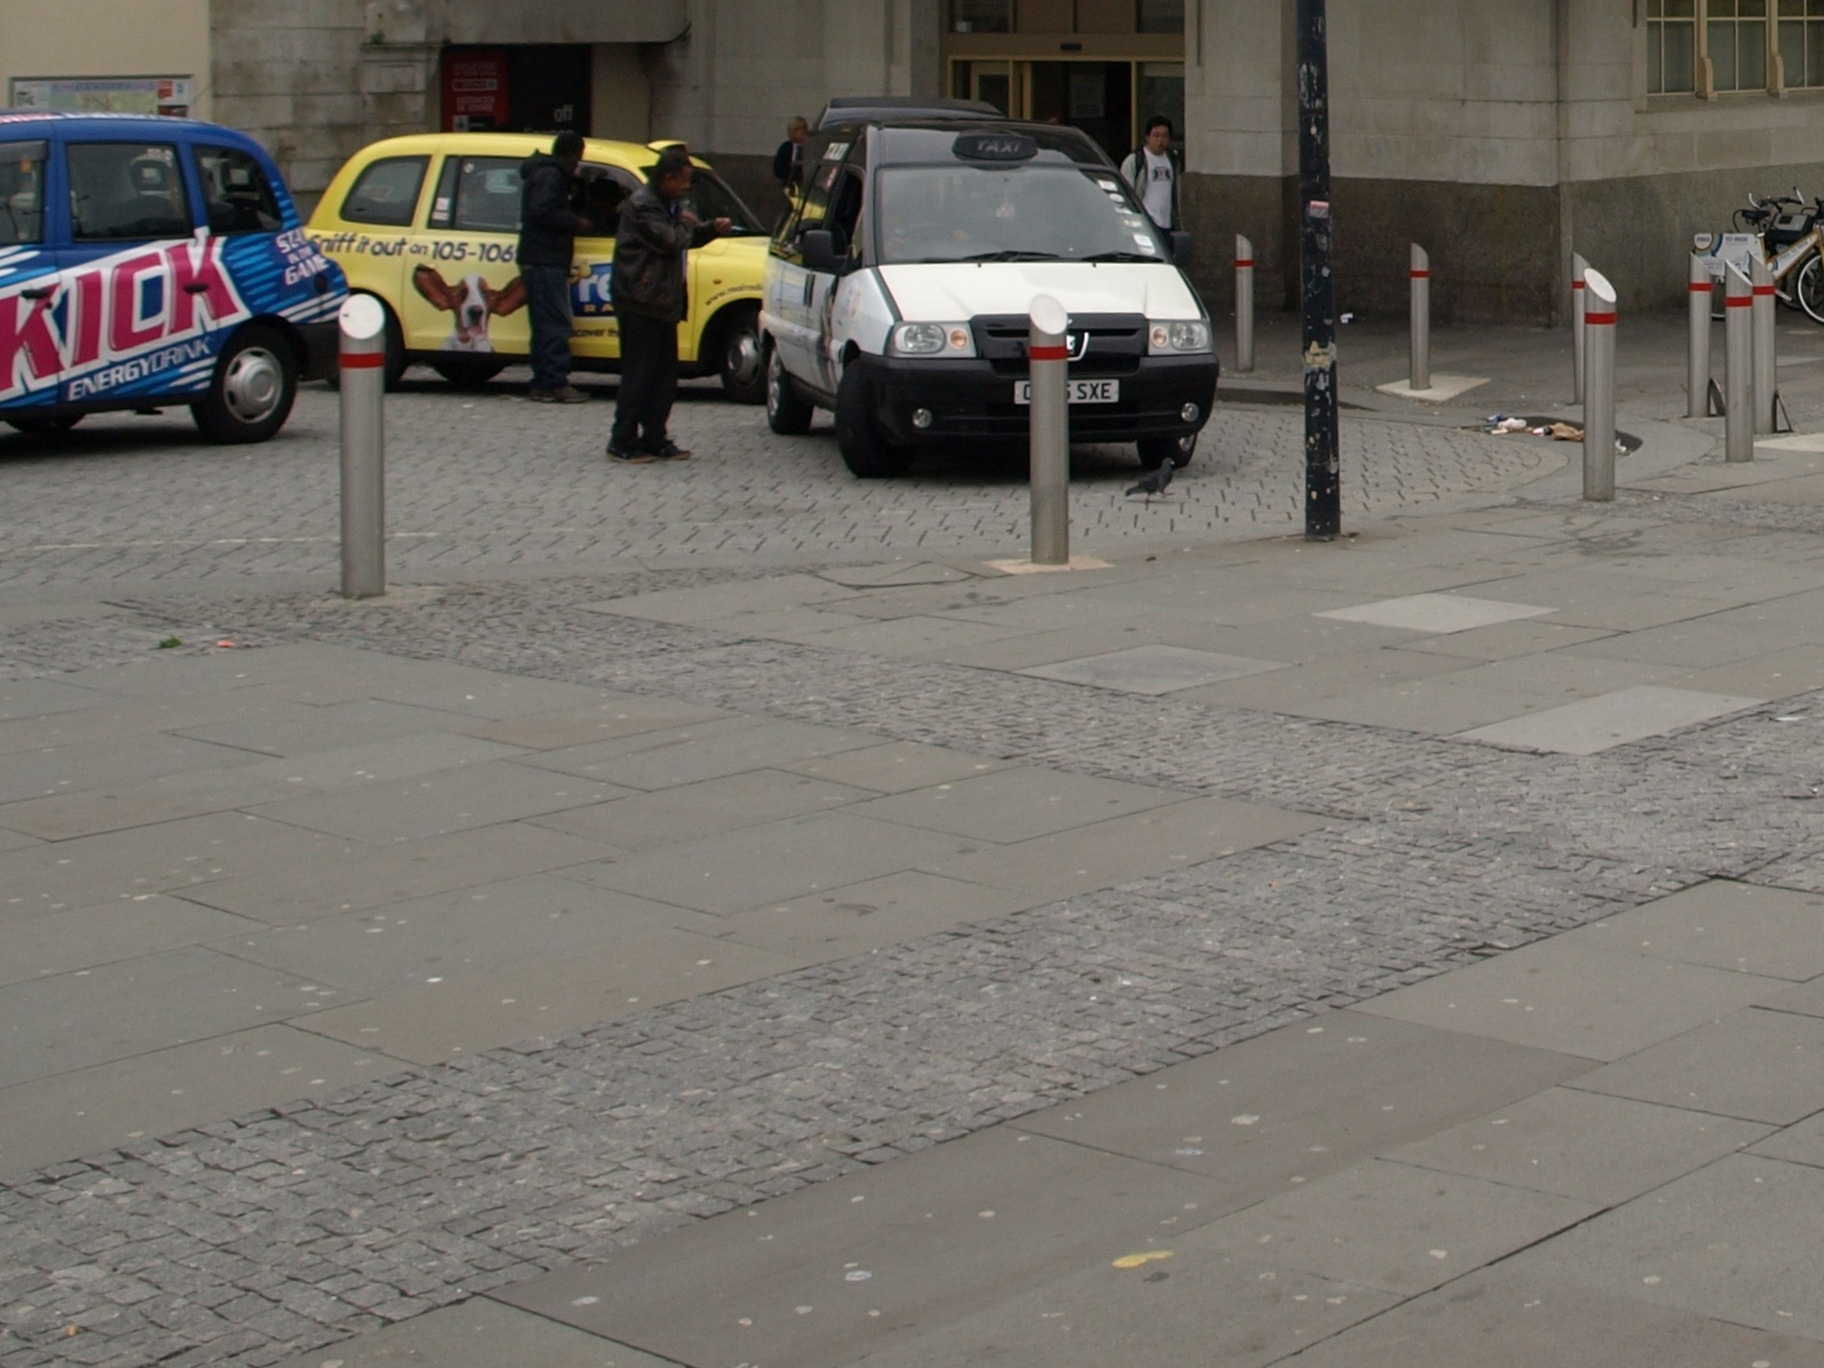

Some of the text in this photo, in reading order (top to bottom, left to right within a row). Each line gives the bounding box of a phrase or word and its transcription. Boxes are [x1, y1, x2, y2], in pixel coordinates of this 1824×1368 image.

[976, 140, 1023, 154] TAXI
[371, 237, 408, 257] out
[410, 244, 429, 256] on
[431, 240, 516, 263] 105-106
[284, 254, 330, 286] GAME
[0, 234, 241, 396] KICK
